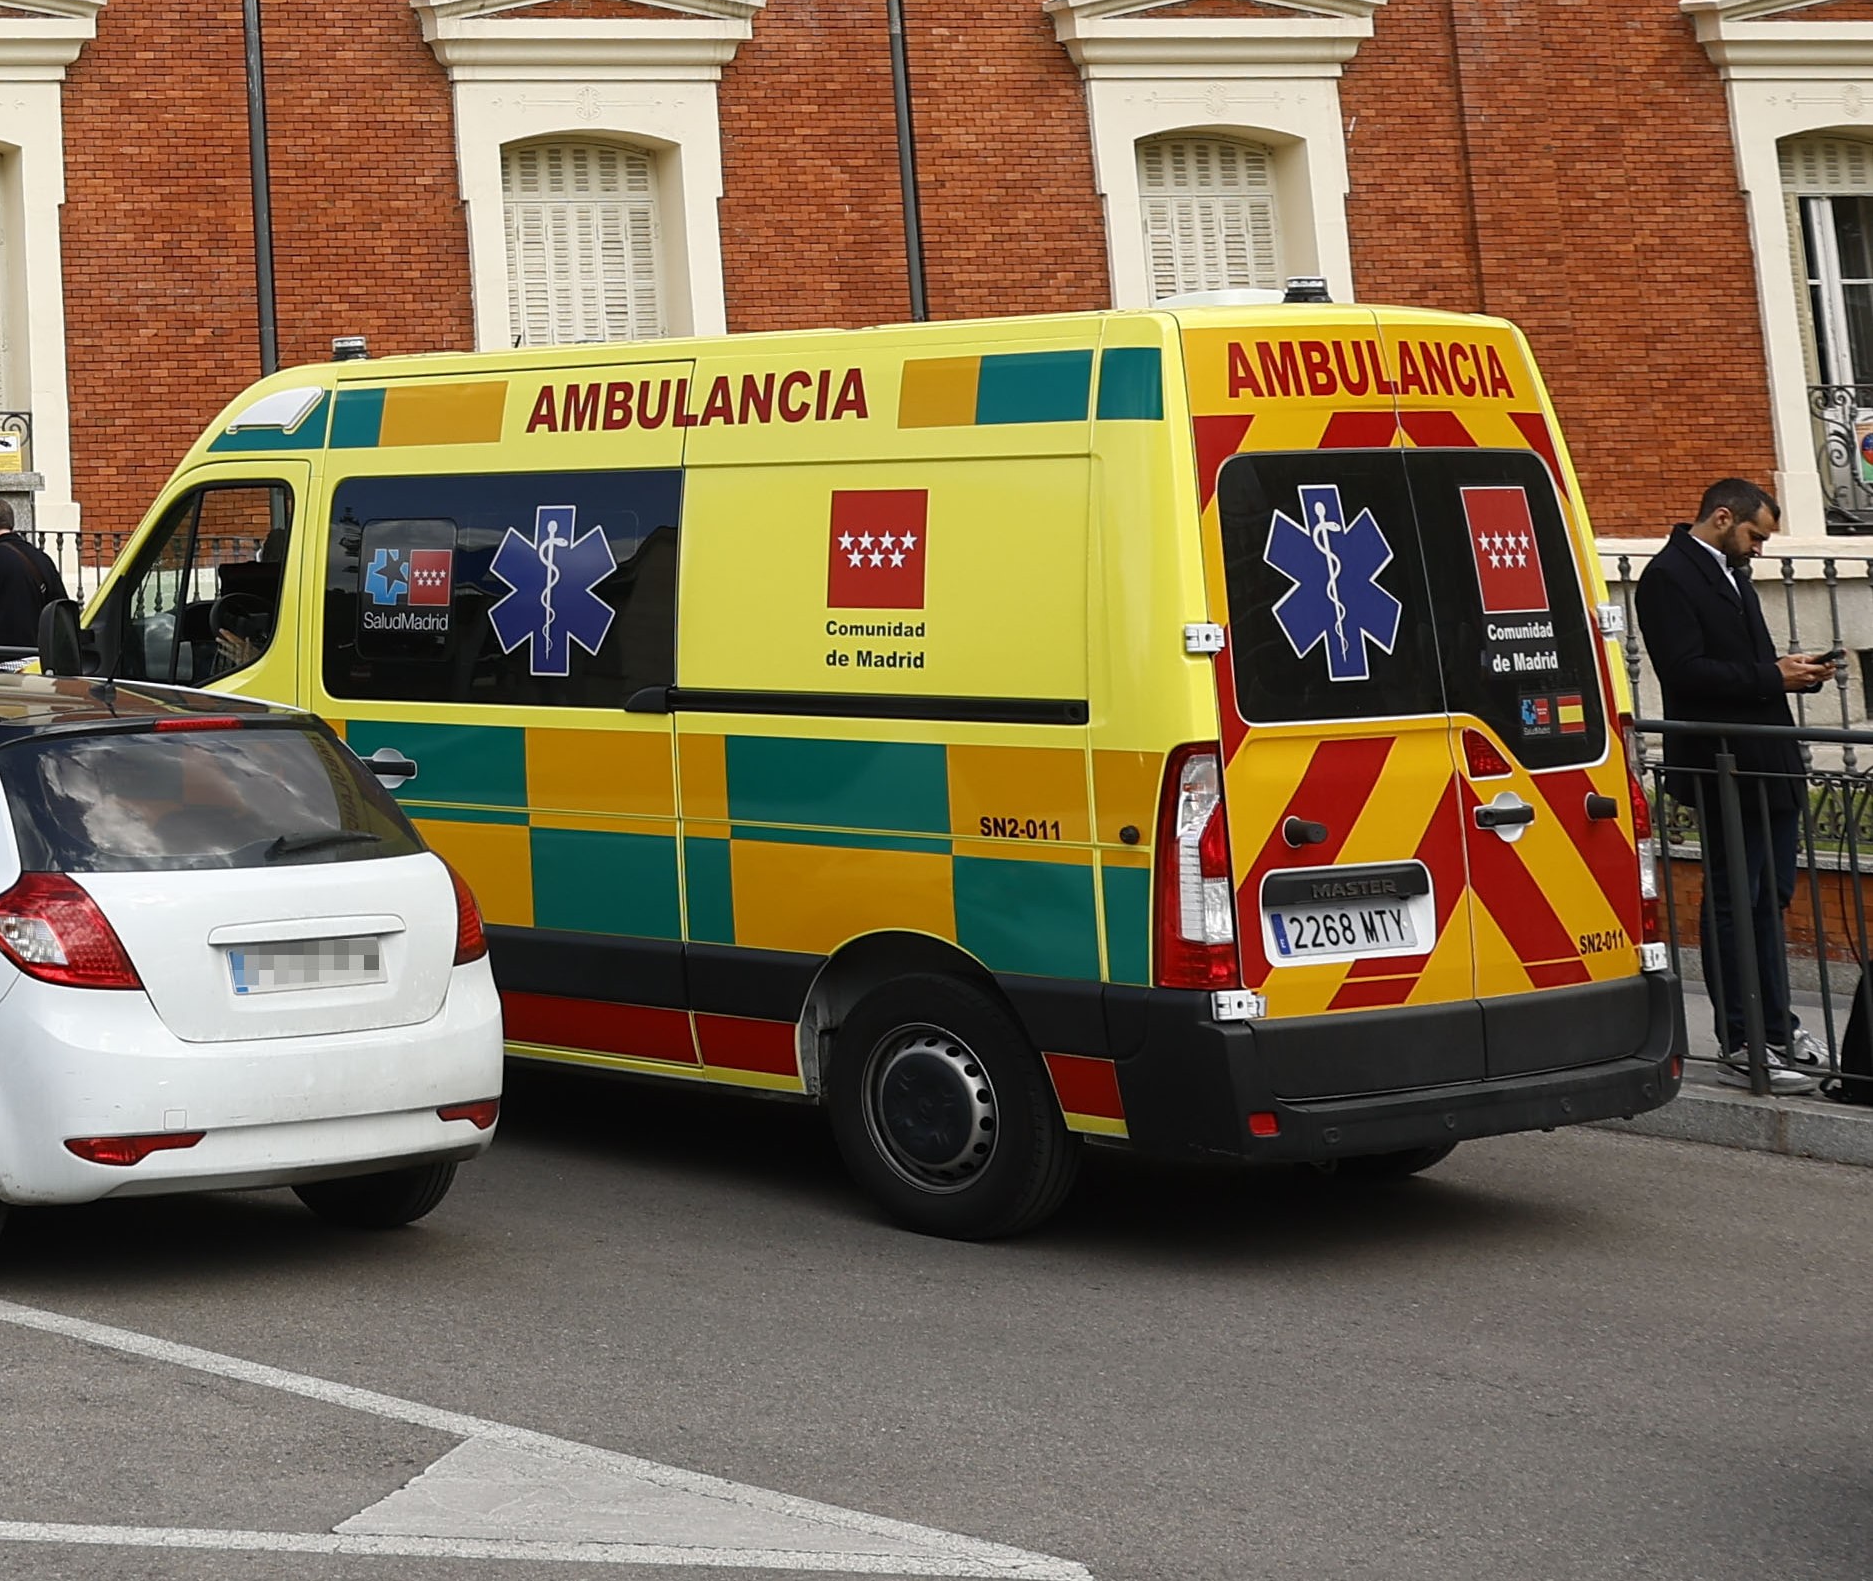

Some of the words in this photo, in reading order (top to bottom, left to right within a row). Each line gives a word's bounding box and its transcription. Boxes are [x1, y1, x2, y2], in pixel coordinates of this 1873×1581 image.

[1226, 340, 1516, 399] AMBULANCIA
[525, 366, 870, 433] AMBULANCIA
[363, 611, 448, 631] SaludMadrid
[826, 620, 925, 637] Comunidad
[1487, 622, 1554, 640] Comunidad
[826, 650, 849, 666] de
[857, 650, 924, 668] Madrid
[1493, 654, 1511, 672] de
[1513, 651, 1558, 671] Madrid
[980, 816, 1060, 840] SN2-011
[1312, 878, 1398, 899] MASTER
[1289, 912, 1355, 950] 2268
[1360, 909, 1405, 942] MTY
[1579, 928, 1625, 955] SN2-011
